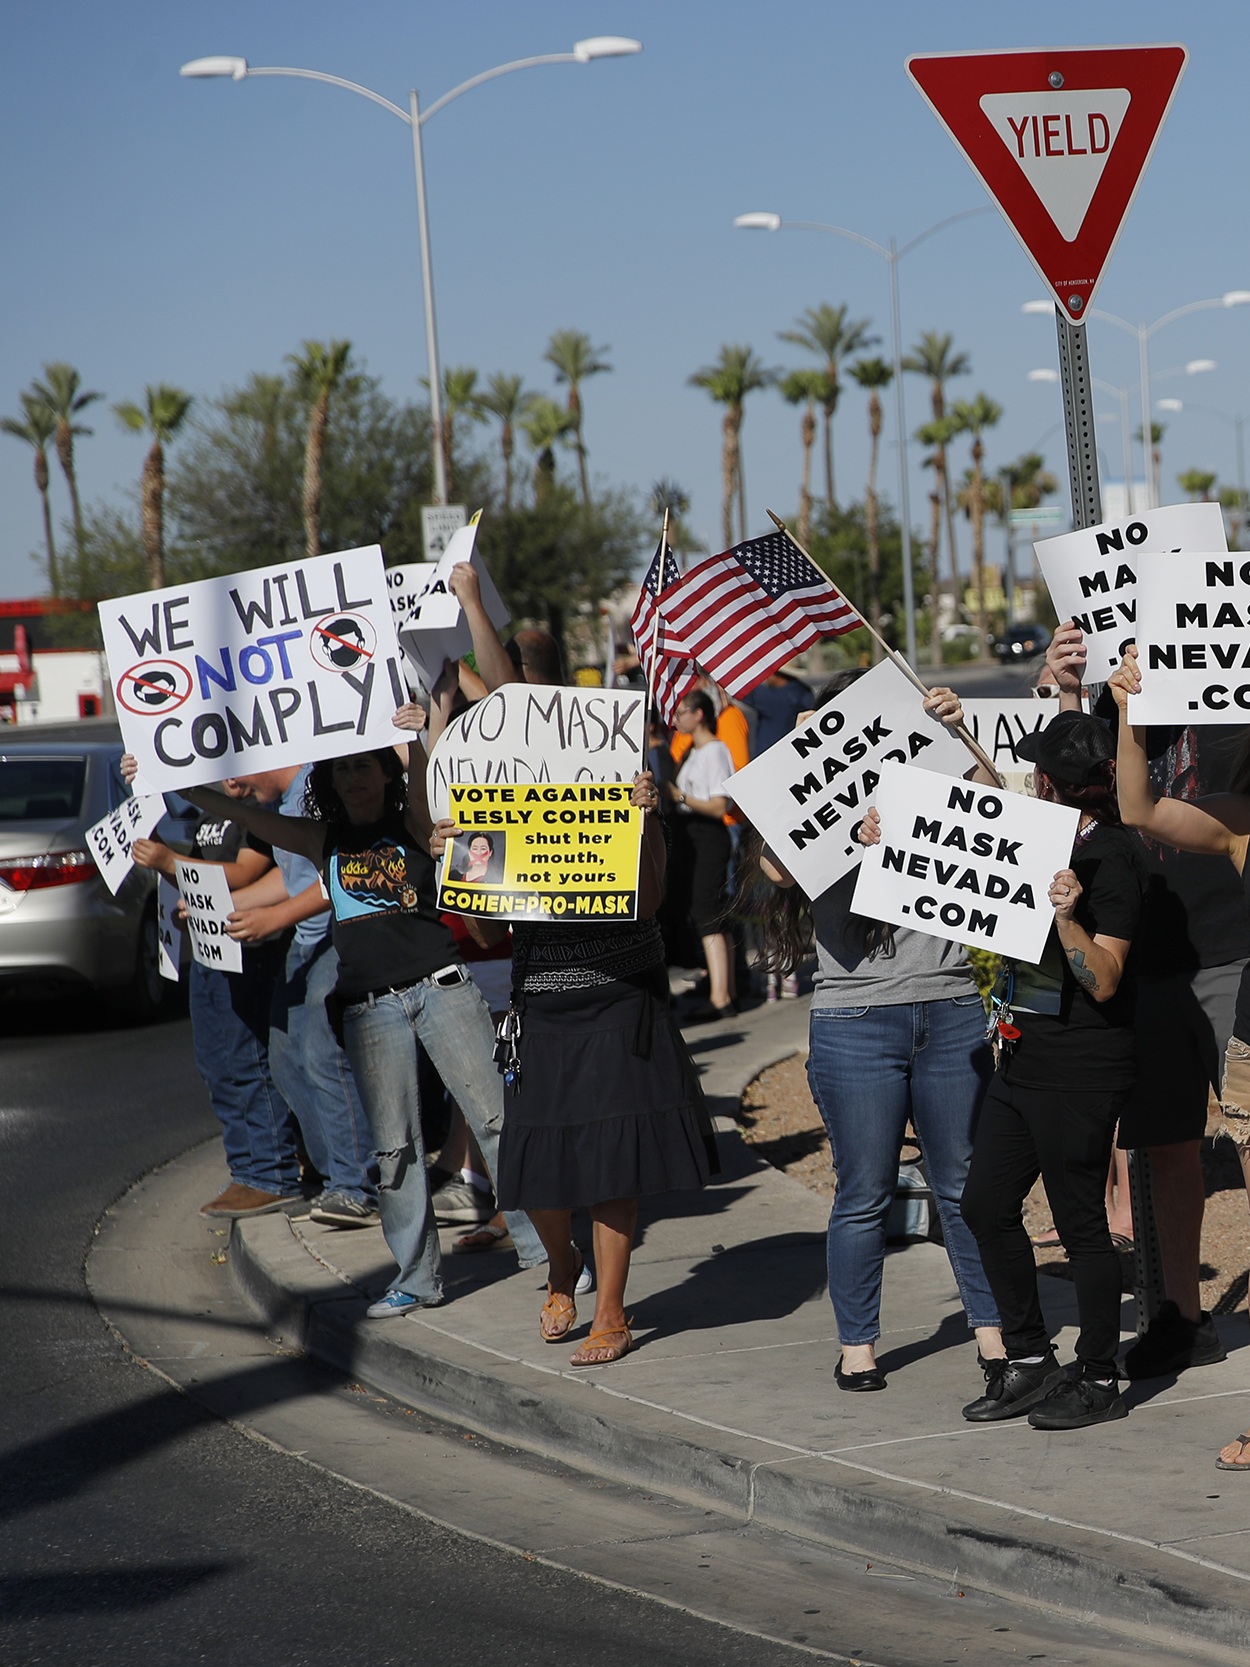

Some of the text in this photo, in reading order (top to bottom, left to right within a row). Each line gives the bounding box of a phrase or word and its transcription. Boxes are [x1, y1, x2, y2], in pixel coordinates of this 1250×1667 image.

[1006, 112, 1110, 158] YIELD
[1095, 522, 1148, 556] NO
[1078, 564, 1137, 598] MA
[118, 596, 194, 657] WE
[228, 562, 373, 634] WILL
[1071, 599, 1137, 635] NEV
[195, 630, 303, 700] NOT
[1108, 637, 1136, 667] .C
[154, 656, 405, 767] COMPLY!
[446, 690, 642, 753] NO MASK
[791, 711, 845, 759] NO
[788, 715, 893, 805] MASK
[451, 787, 634, 803] VOTE AGAINST
[947, 786, 1003, 819] NO
[459, 809, 630, 825] LESLY COHEN
[525, 832, 612, 845] shut her
[912, 815, 1023, 866] MASK
[531, 851, 604, 865] mouth,
[182, 867, 199, 884] NO
[516, 871, 616, 885] not yours
[881, 846, 1036, 909] NEVADA
[182, 889, 215, 911] MASK
[442, 890, 630, 914] COHEN=PRO-MASK
[901, 895, 998, 937] .COM
[189, 915, 229, 937] EVADA
[198, 941, 223, 961] COM
